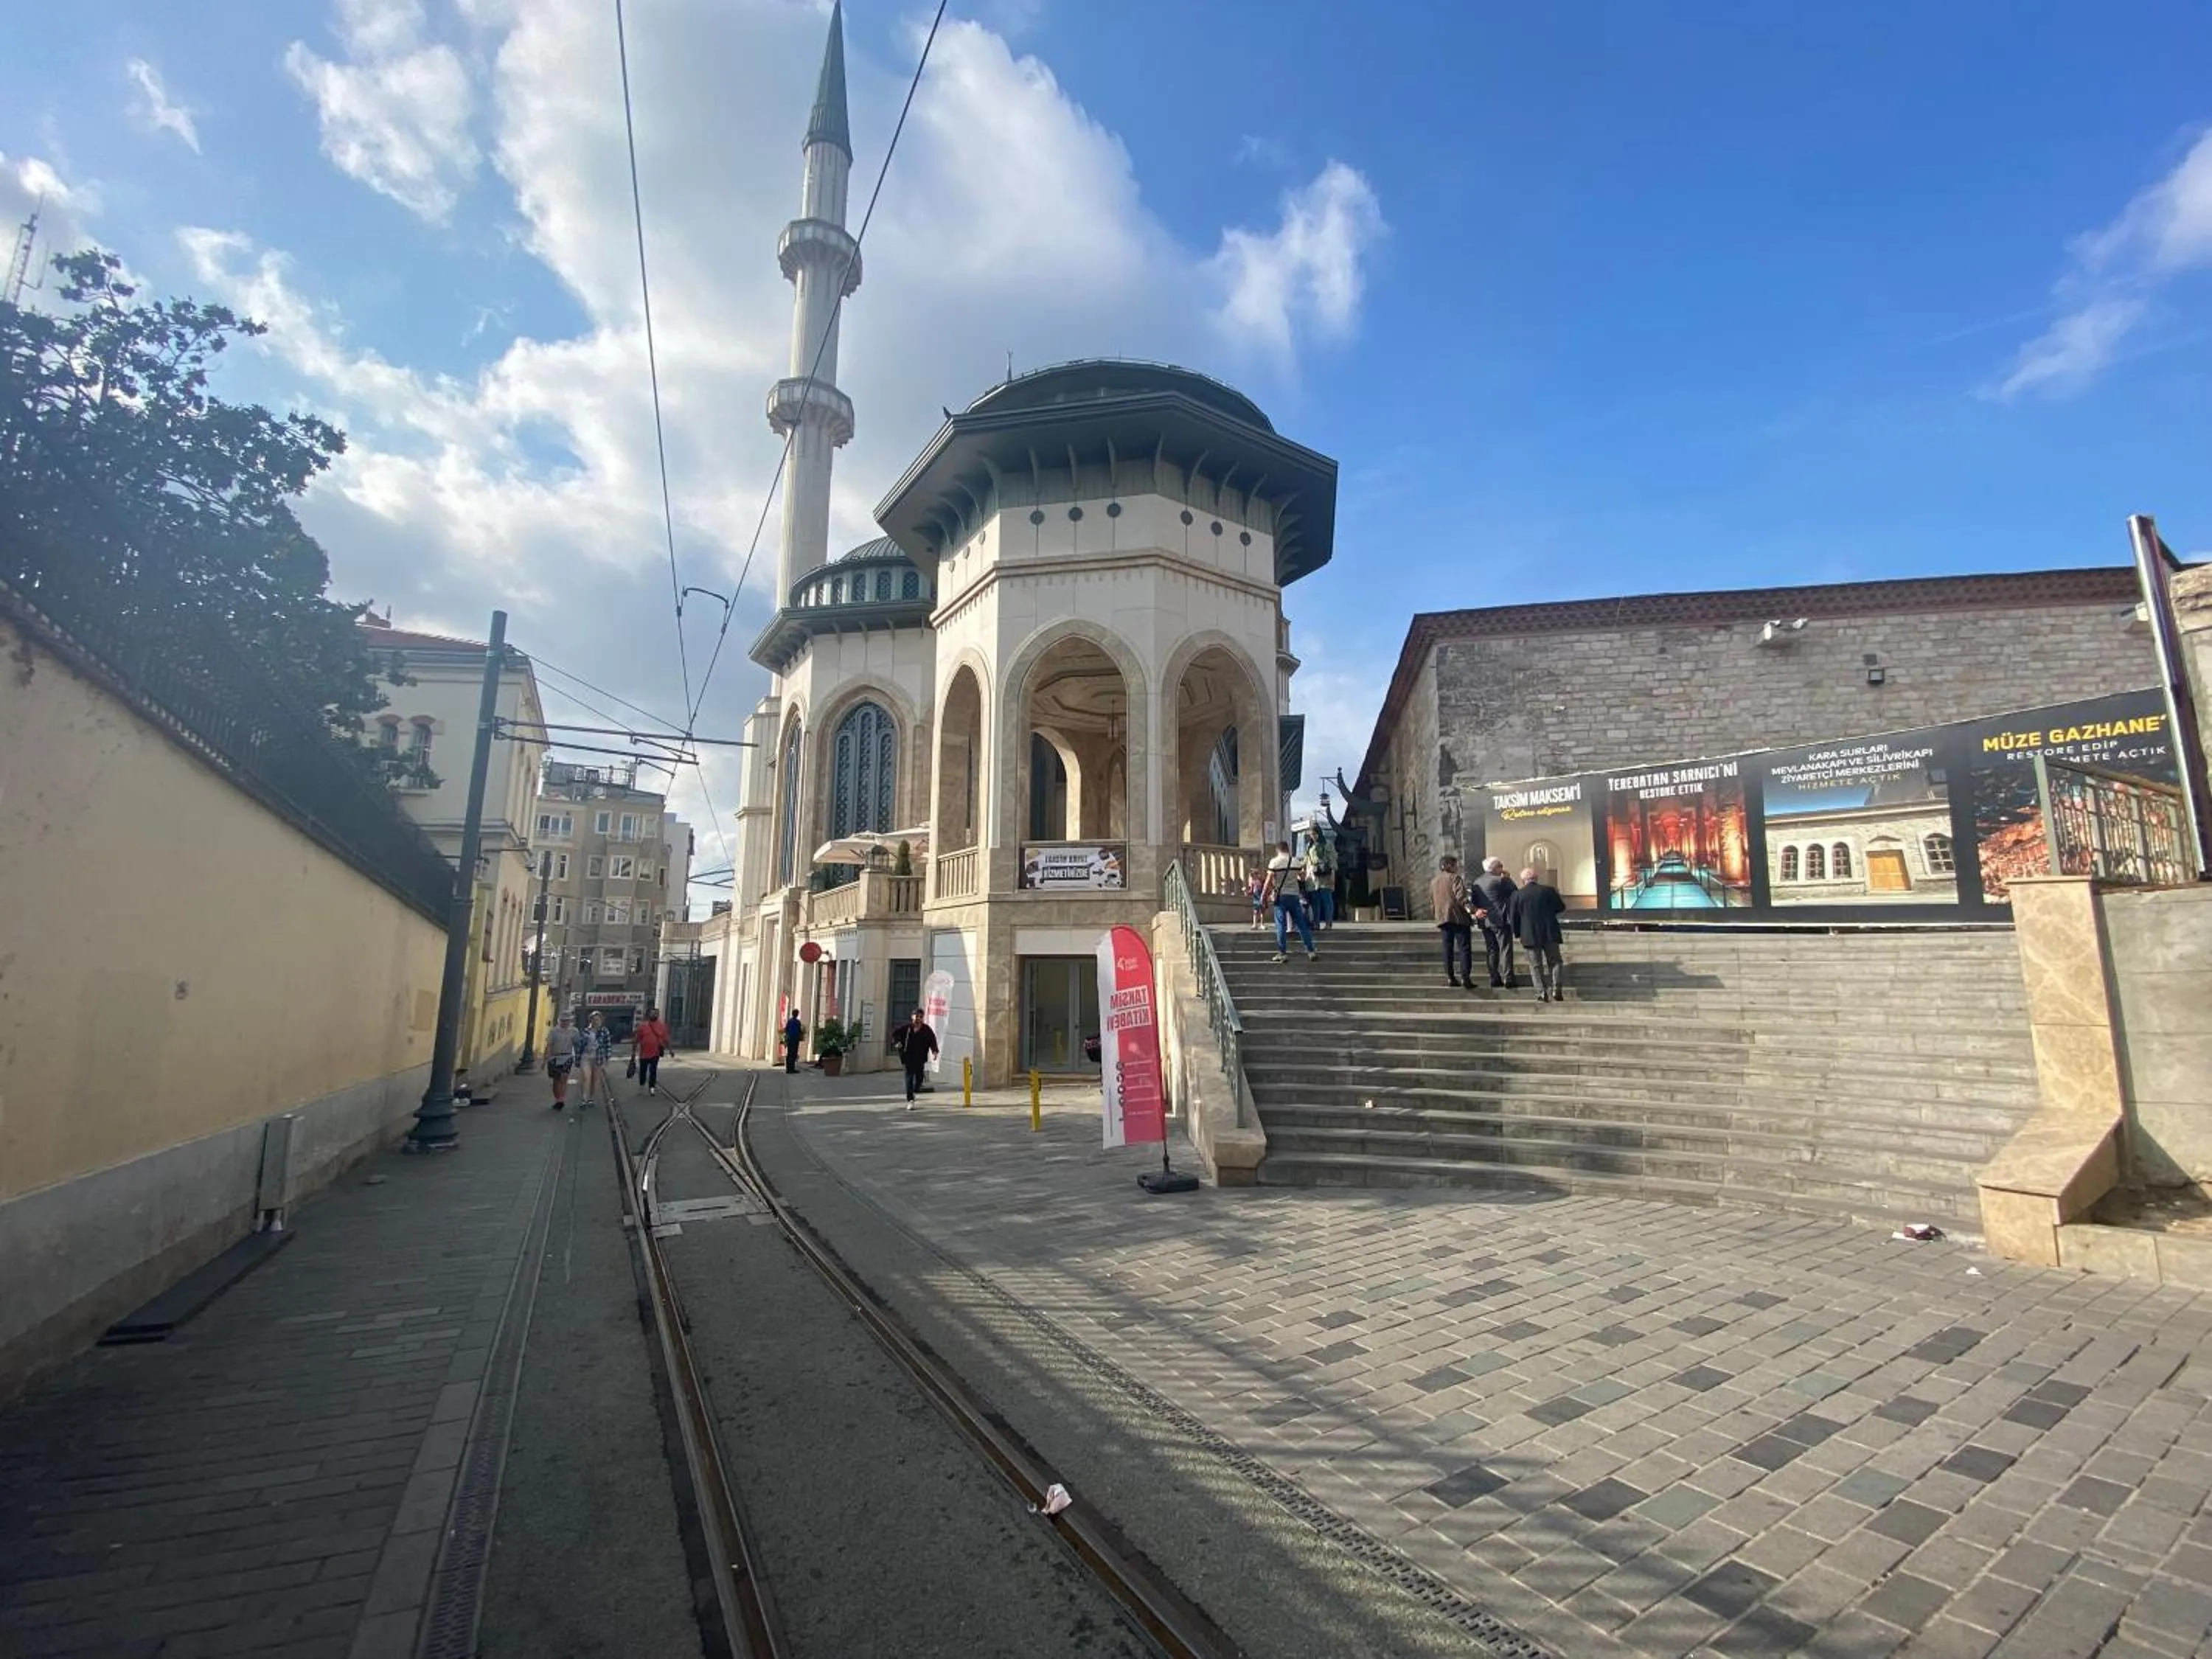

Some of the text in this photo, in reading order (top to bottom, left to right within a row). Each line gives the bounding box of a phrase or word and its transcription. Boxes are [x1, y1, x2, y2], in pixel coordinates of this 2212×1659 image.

[1982, 731, 2041, 752] MÜZE
[1809, 743, 1888, 762] KARA SURLARI
[2006, 745, 2076, 761] RESTORE
[1771, 759, 1847, 776] MEVLANAKAPI
[1848, 757, 1864, 766] VE
